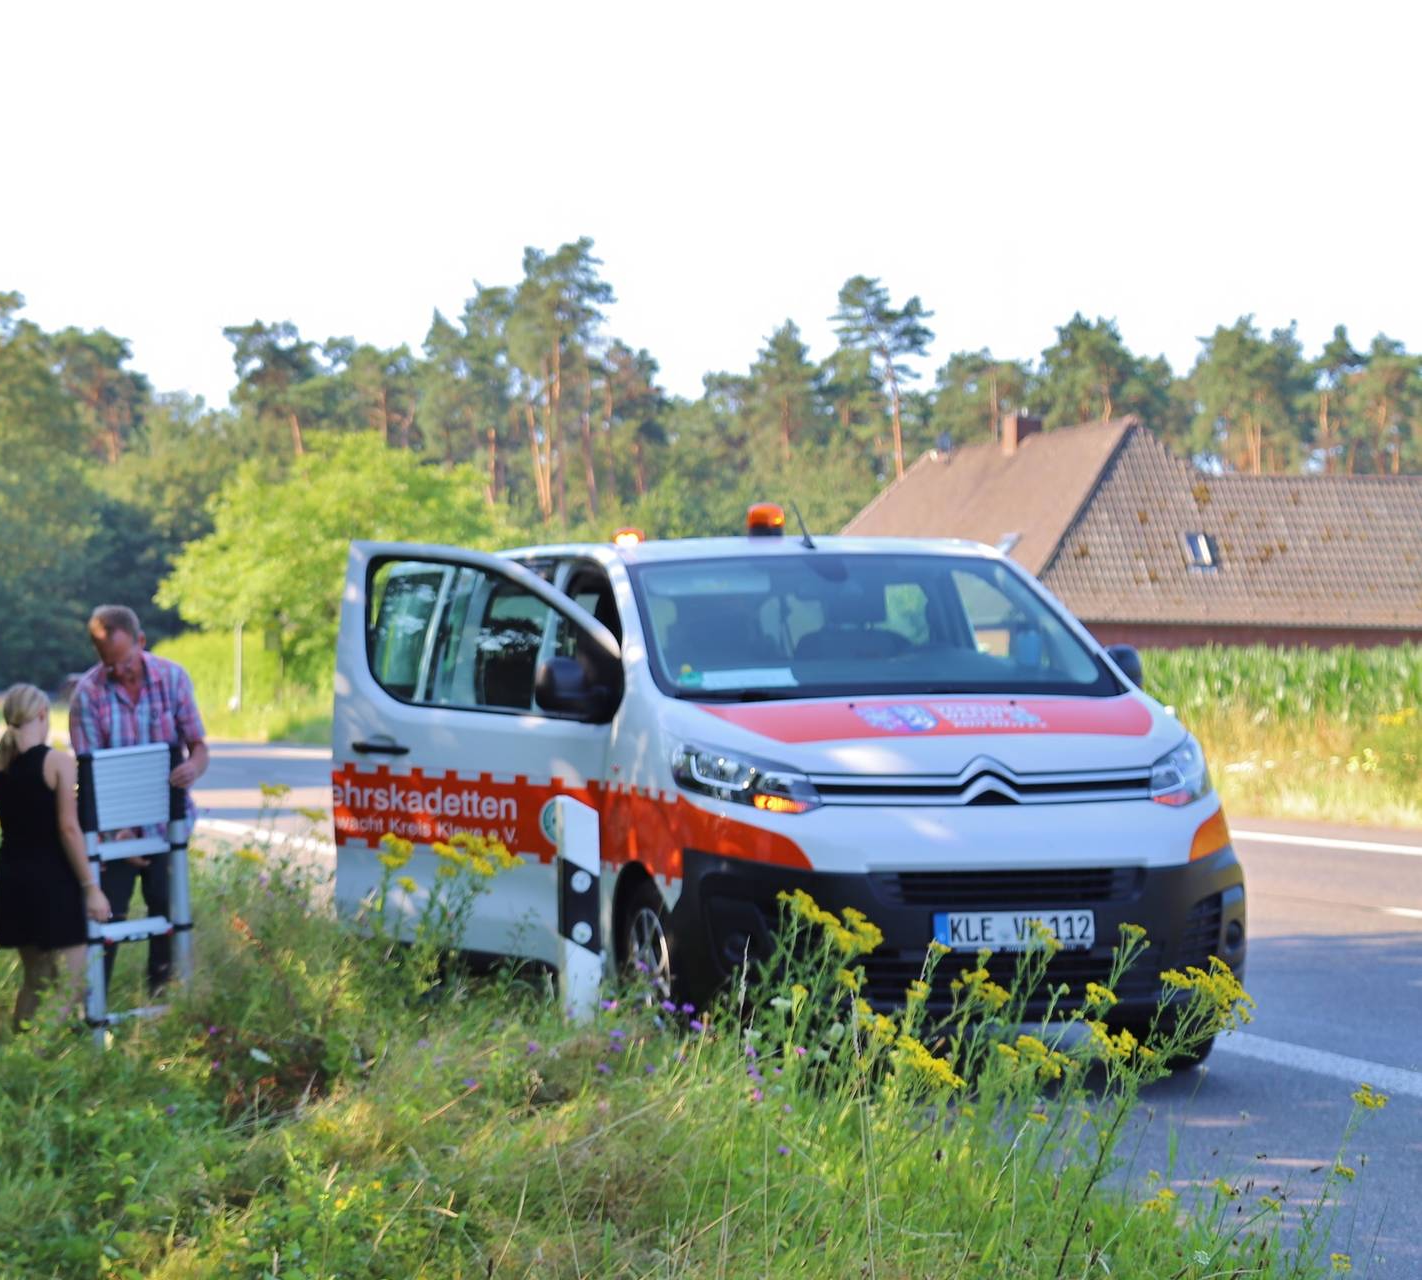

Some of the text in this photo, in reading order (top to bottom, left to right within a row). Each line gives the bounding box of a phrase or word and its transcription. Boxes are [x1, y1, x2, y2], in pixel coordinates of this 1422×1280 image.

[388, 817, 431, 837] Kreis
[949, 916, 994, 943] KLE
[1049, 915, 1091, 940] 112
